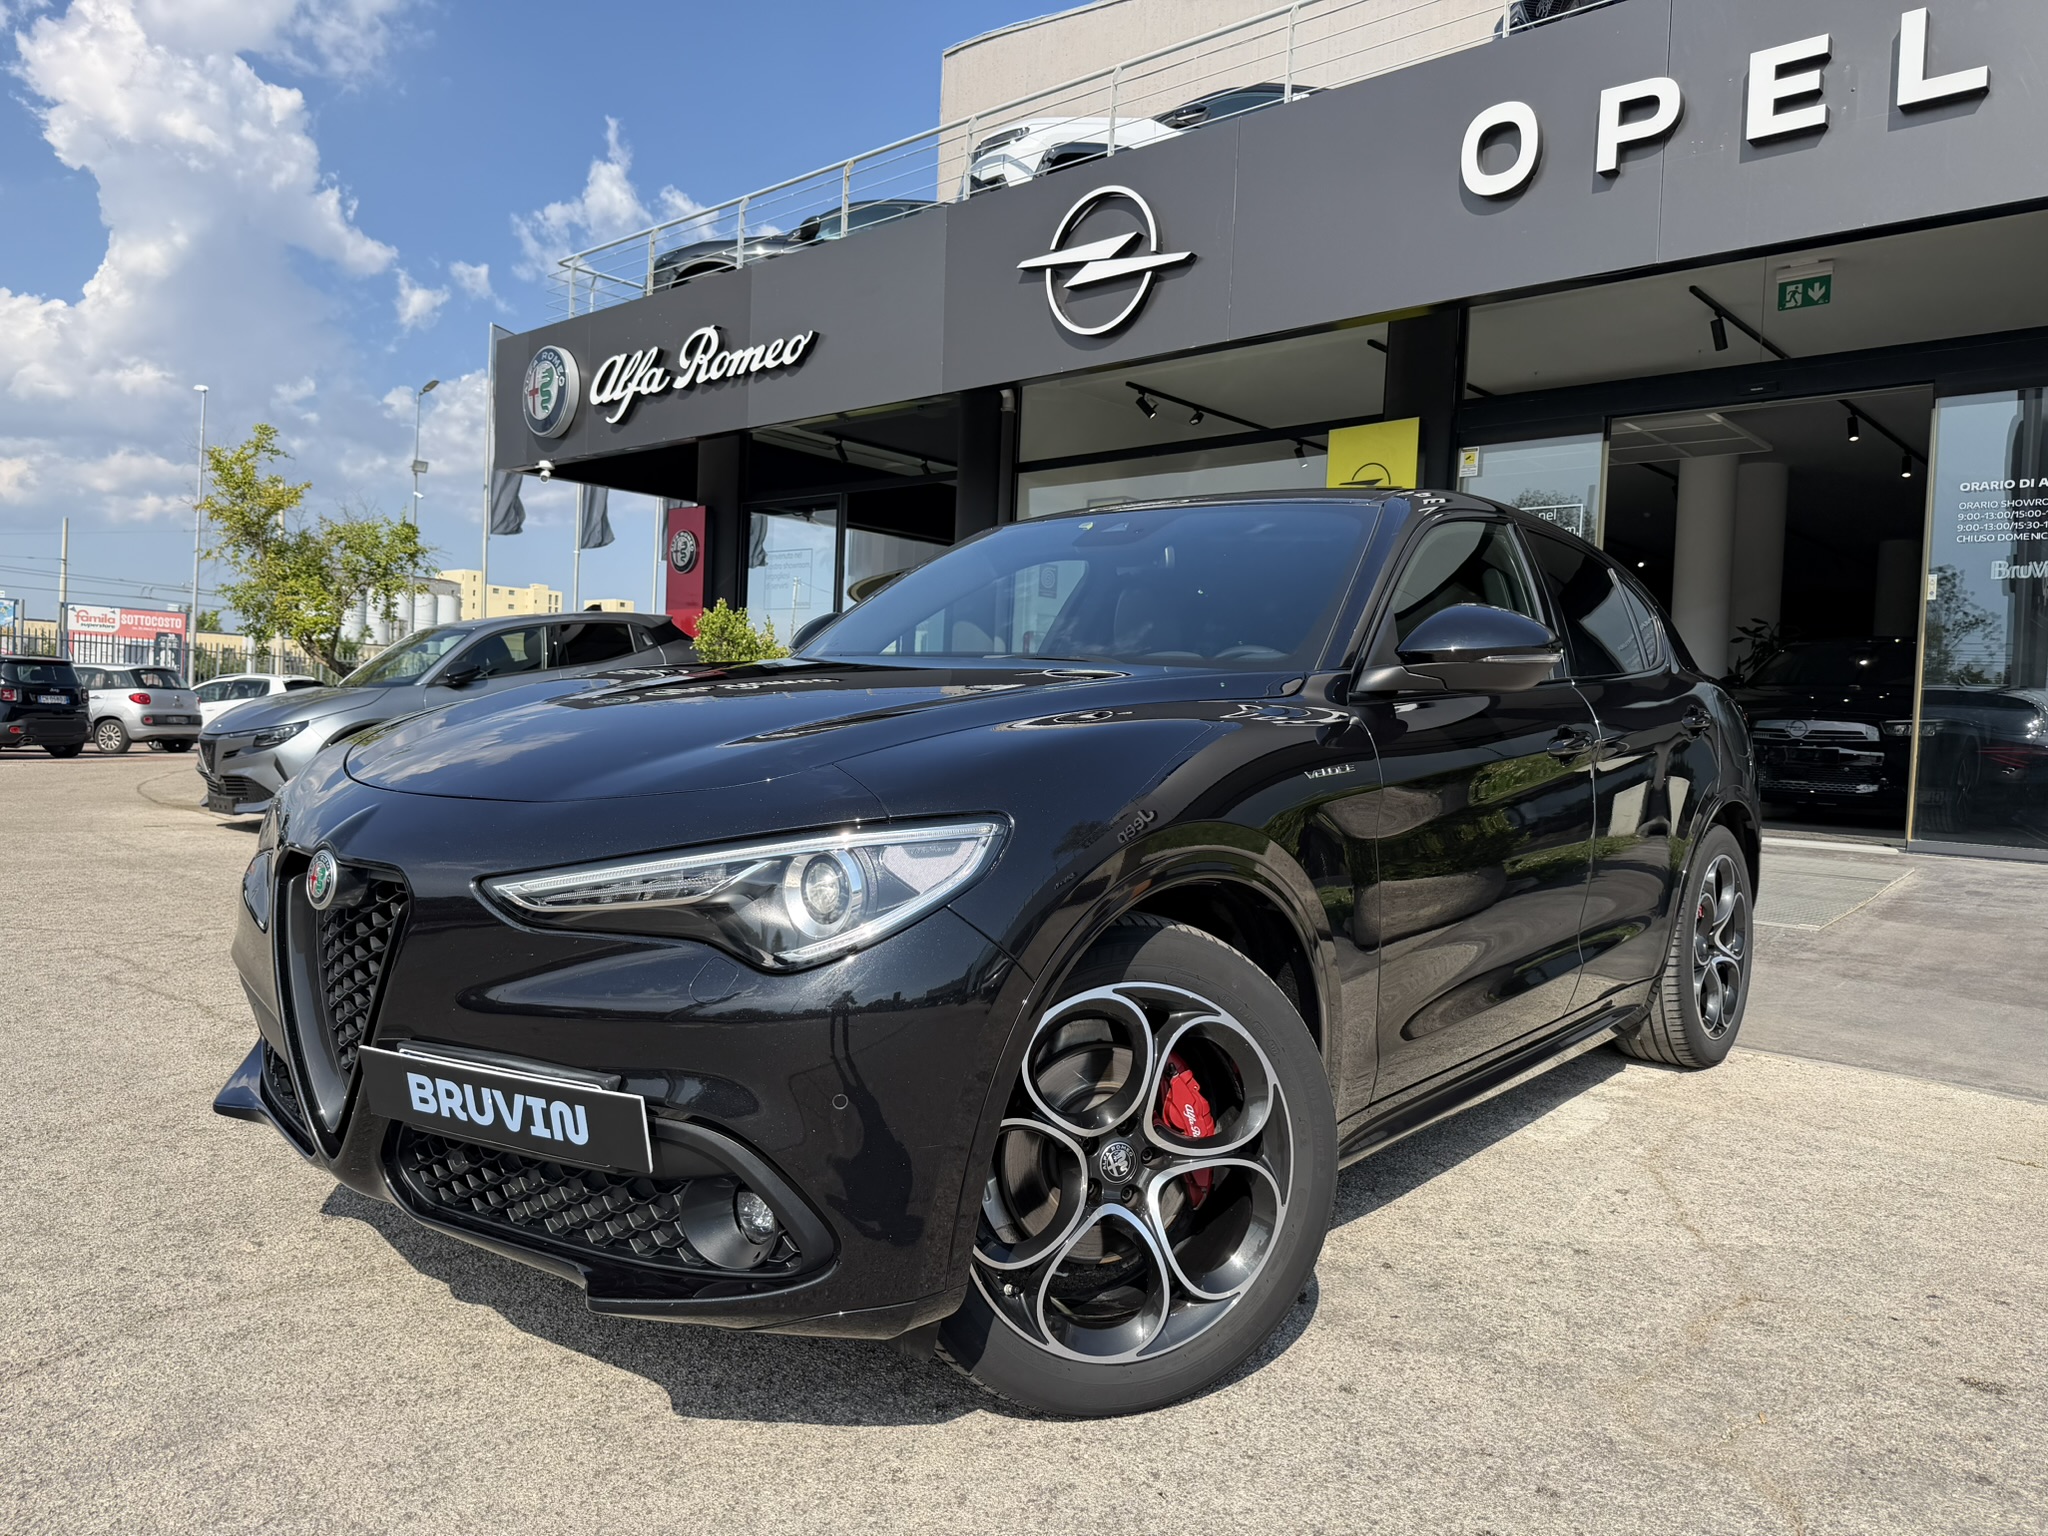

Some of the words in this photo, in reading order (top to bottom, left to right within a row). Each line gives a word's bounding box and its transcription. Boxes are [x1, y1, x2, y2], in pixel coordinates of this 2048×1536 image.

[1461, 7, 1990, 196] OPEL
[589, 346, 671, 424] Alfa
[673, 325, 814, 389] Romeo
[1960, 480, 2015, 492] ORARIO
[2019, 478, 2035, 489] DI
[1959, 501, 1998, 509] ORARIO
[1956, 533, 1995, 543] CHIUSO
[74, 610, 116, 624] famila
[121, 614, 182, 629] SOTTOCOSTO
[1303, 764, 1356, 779] VELOCE
[406, 1072, 589, 1146] BRUVIN
[1111, 1143, 1134, 1157] ROMEO
